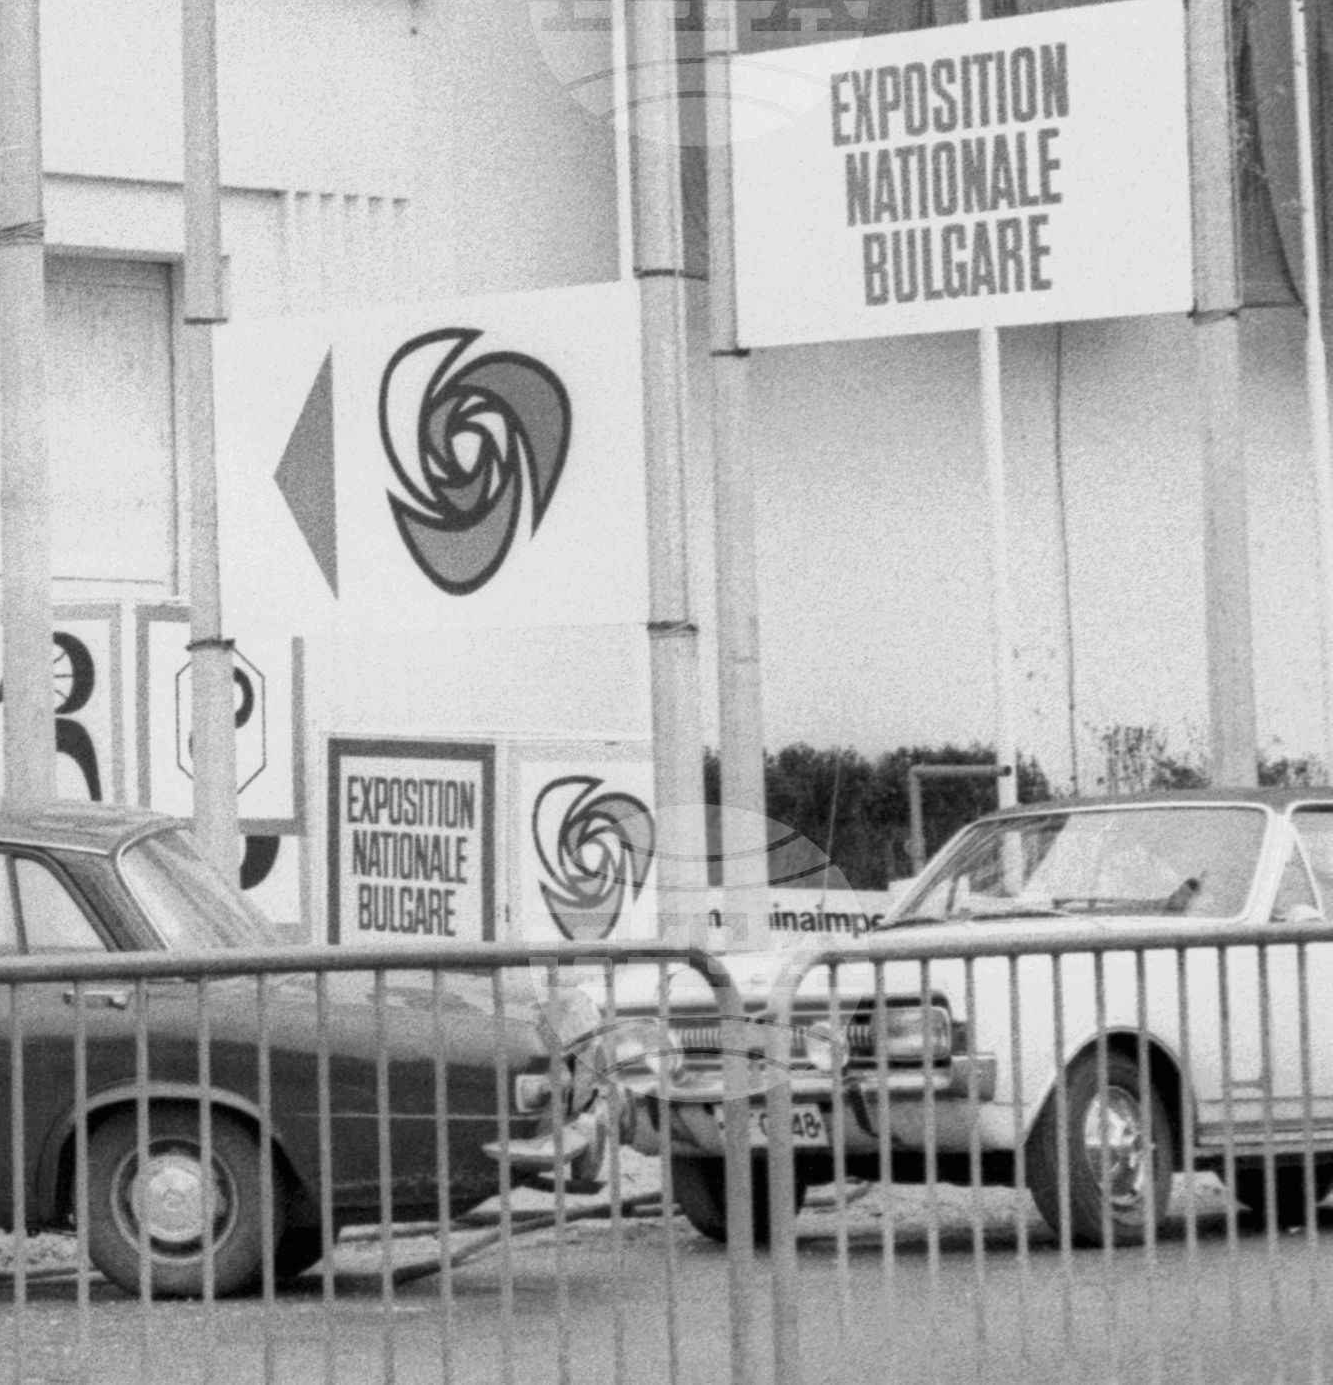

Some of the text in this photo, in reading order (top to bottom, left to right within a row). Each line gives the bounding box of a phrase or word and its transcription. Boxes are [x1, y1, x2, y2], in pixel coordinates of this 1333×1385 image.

[830, 41, 1070, 147] EXPOSITION
[844, 127, 1063, 227] NATIONALE
[862, 213, 1052, 306] BULGARE
[345, 774, 475, 831] EXPOSITION
[351, 829, 468, 885] NATIONALE
[357, 883, 456, 937] BULGARE
